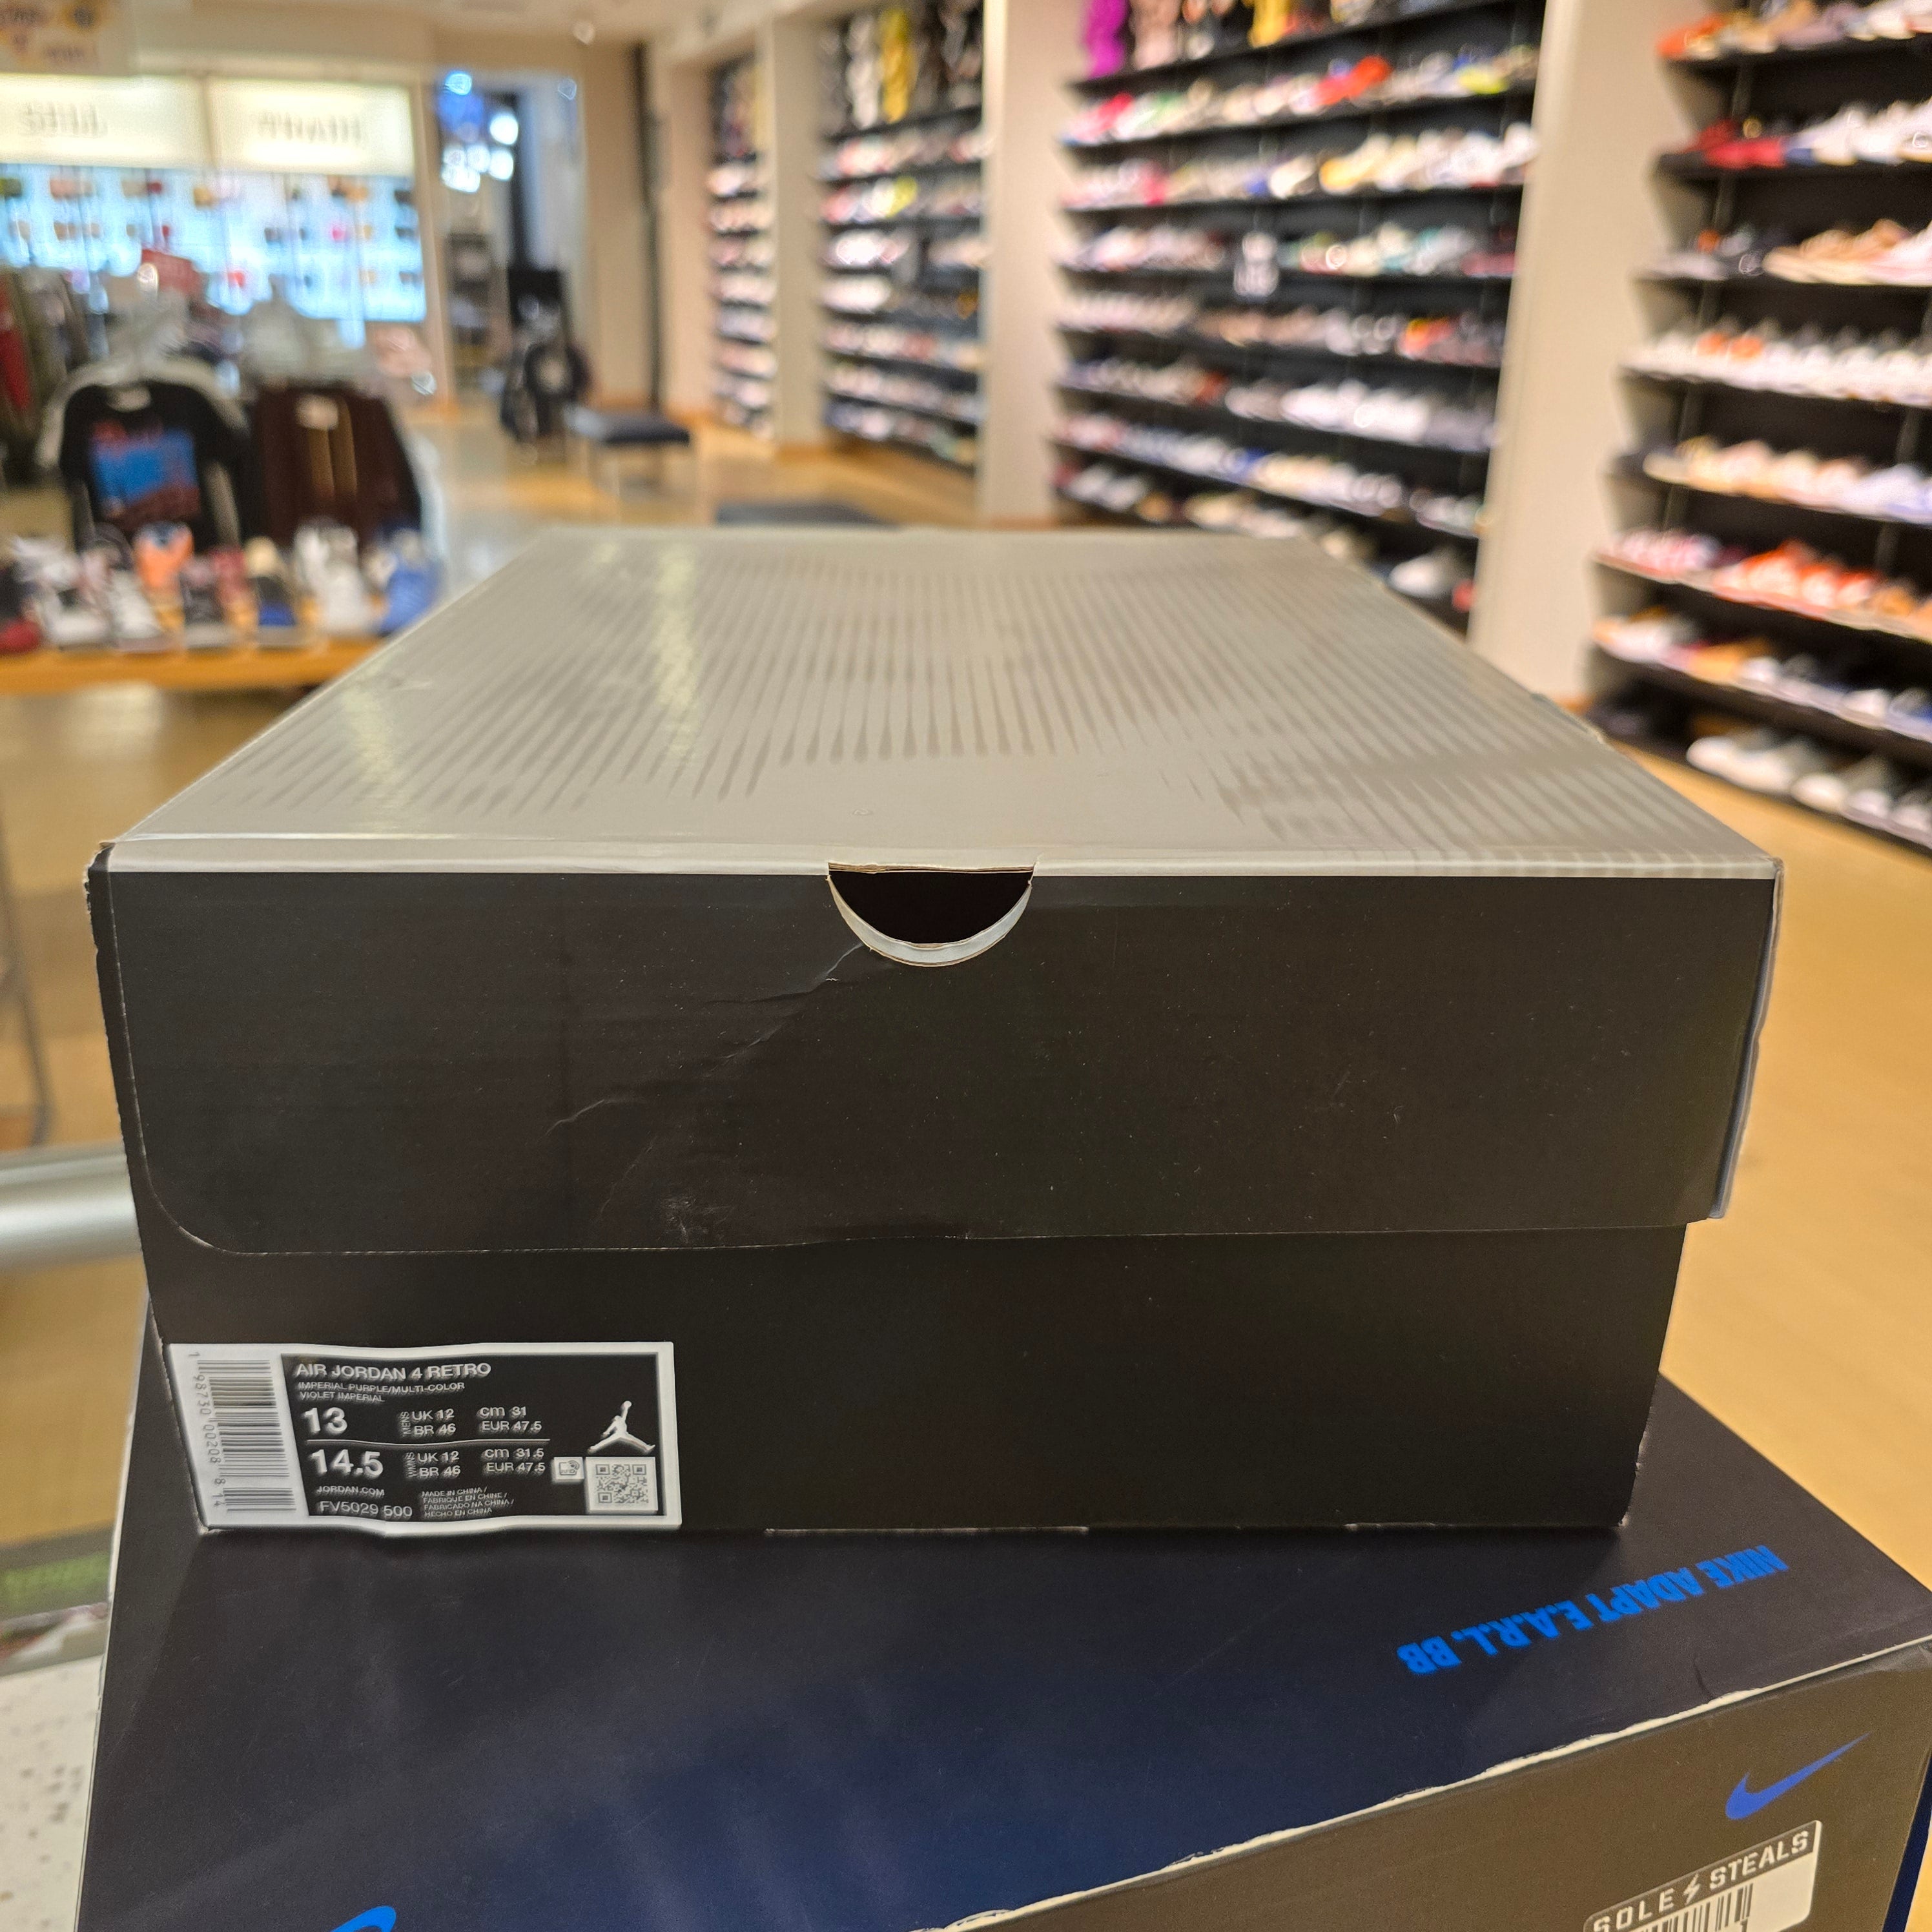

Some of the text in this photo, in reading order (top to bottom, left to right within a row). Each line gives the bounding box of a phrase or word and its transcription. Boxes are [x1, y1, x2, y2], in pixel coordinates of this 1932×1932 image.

[295, 1363, 491, 1379] AIR JORDAN 4 RETRO
[298, 1382, 465, 1393] IMPERIAL PURPLE/MULTI-COLOR
[300, 1392, 385, 1403] VIOLET IMPERIAL
[412, 1408, 455, 1421] UK 12
[478, 1406, 527, 1417] cm 31
[194, 1374, 212, 1415] 98730
[203, 1424, 222, 1463] 00208
[303, 1407, 347, 1434] 13
[400, 1411, 411, 1435] MENS
[413, 1423, 456, 1435] BR 46
[481, 1421, 542, 1432] EUR 47.5
[418, 1451, 459, 1463] UK 12
[484, 1448, 544, 1459] cm 31.5
[311, 1449, 384, 1476] 14.5
[406, 1452, 417, 1478] WMNS
[486, 1462, 546, 1472] EUR 47.5
[419, 1465, 461, 1477] BR 46
[316, 1486, 385, 1497] JORDAN.COM
[320, 1501, 413, 1517] FV5029 500
[1397, 1544, 1789, 1674] NIKE ADAPT E.A.R.L. BB
[1593, 1830, 1809, 1932] SOLE STEALS
